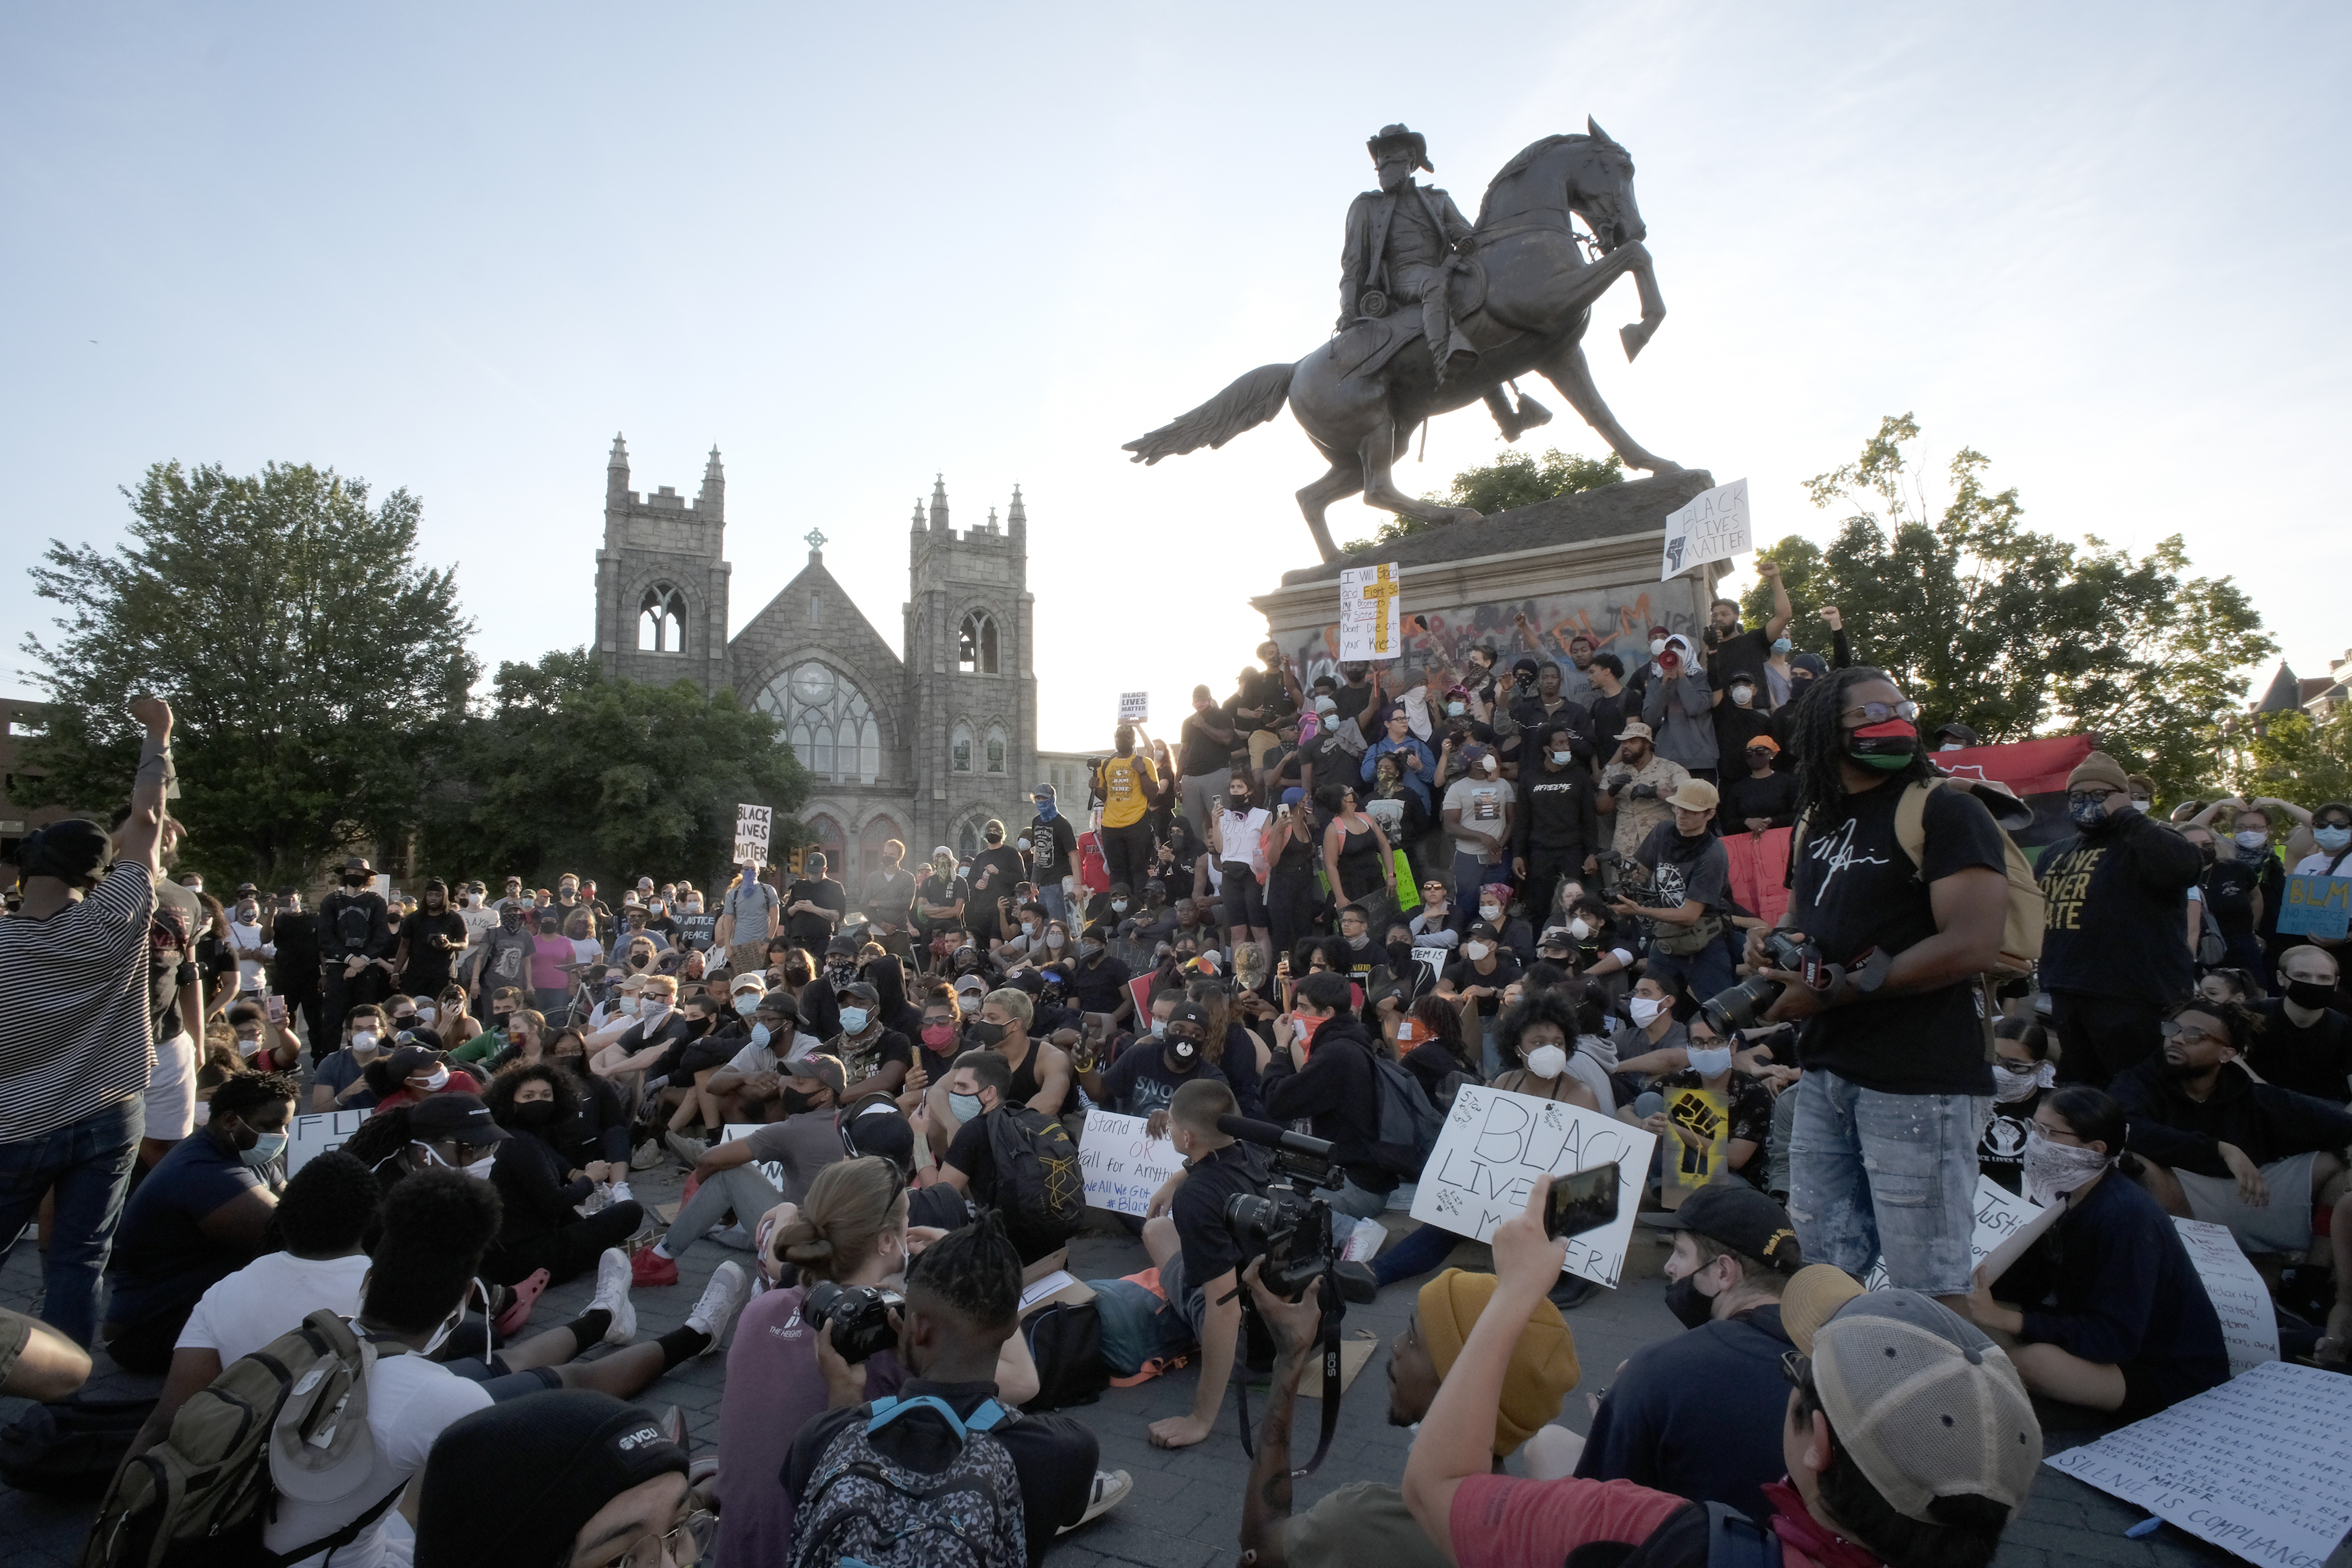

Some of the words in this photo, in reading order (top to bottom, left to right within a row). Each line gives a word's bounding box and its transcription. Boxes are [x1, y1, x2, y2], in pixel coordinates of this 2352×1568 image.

[1683, 488, 1745, 534] BLACK
[1696, 514, 1739, 540] LIVES
[1683, 530, 1745, 566] MATTER
[1342, 572, 1354, 584] I
[1377, 567, 1398, 579] Stand
[1342, 587, 1358, 597] and
[1364, 586, 1385, 597] Fight
[1358, 599, 1386, 608] Brothers
[1354, 610, 1384, 620] Sisters
[1367, 623, 1381, 633] Die
[1385, 620, 1398, 631] at
[1343, 639, 1361, 657] your
[737, 807, 769, 823] BLACK
[736, 823, 767, 840] LIVES
[734, 842, 767, 861] MATTER
[2046, 848, 2107, 874] LOVE
[2040, 874, 2091, 902] OVER
[2289, 878, 2349, 910] BLM
[684, 916, 715, 925] JUSTICE
[2044, 901, 2083, 930] ATE
[682, 931, 709, 940] PEACE
[1433, 951, 1444, 959] IS
[1135, 1075, 1174, 1099] SNO
[1088, 1112, 1130, 1135] Stand
[1130, 1140, 1154, 1162] OR
[1078, 1148, 1100, 1168] Fall
[1106, 1157, 1125, 1172] for
[1134, 1164, 1175, 1182] Anythi
[1084, 1180, 1097, 1192] We
[1098, 1180, 1111, 1193] All
[1114, 1182, 1126, 1196] We
[1130, 1185, 1151, 1199] Got
[1438, 1148, 1536, 1208] LIVE
[770, 1325, 782, 1335] THE
[780, 1329, 803, 1338] HEIGHTS
[2254, 1341, 2276, 1353] and
[1327, 1352, 1336, 1377] EOS
[2260, 1363, 2304, 1376] BLACK
[2311, 1373, 2352, 1386] LIVES
[2304, 1383, 2349, 1397] BLACK
[2217, 1385, 2254, 1399] BLACK
[2261, 1396, 2300, 1408] LIVES
[2301, 1406, 2352, 1421] MATTE
[2164, 1409, 2206, 1424] BLACK
[2210, 1421, 2253, 1435] LIVES
[2184, 1401, 2225, 1413] LIVES
[2284, 1425, 2332, 1440] BLACK
[2254, 1406, 2298, 1420] BLACK
[2303, 1418, 2348, 1433] LIVES
[629, 1427, 659, 1443] VCU
[2214, 1435, 2255, 1450] BLACK
[2264, 1447, 2305, 1464] LIVES
[2121, 1429, 2157, 1443] BLACK
[2161, 1441, 2194, 1456] LIVES
[2264, 1474, 2310, 1493] BLACK
[2316, 1491, 2352, 1509] LIVE
[2151, 1450, 2189, 1465] BLACK
[2196, 1463, 2232, 1478] LIVES
[2244, 1455, 2291, 1475] BLACK
[2298, 1472, 2351, 1492] LIVES
[2059, 1454, 2151, 1497] SILENCE
[2153, 1492, 2185, 1509] IS
[2094, 1441, 2124, 1454] LIVES
[2183, 1469, 2219, 1486] BLACK
[2226, 1486, 2270, 1504] LIVES
[2277, 1503, 2341, 1530] MATTE
[2125, 1459, 2161, 1474] LIVES
[2230, 1495, 2279, 1517] BLACK
[2291, 1519, 2338, 1539] LIVES
